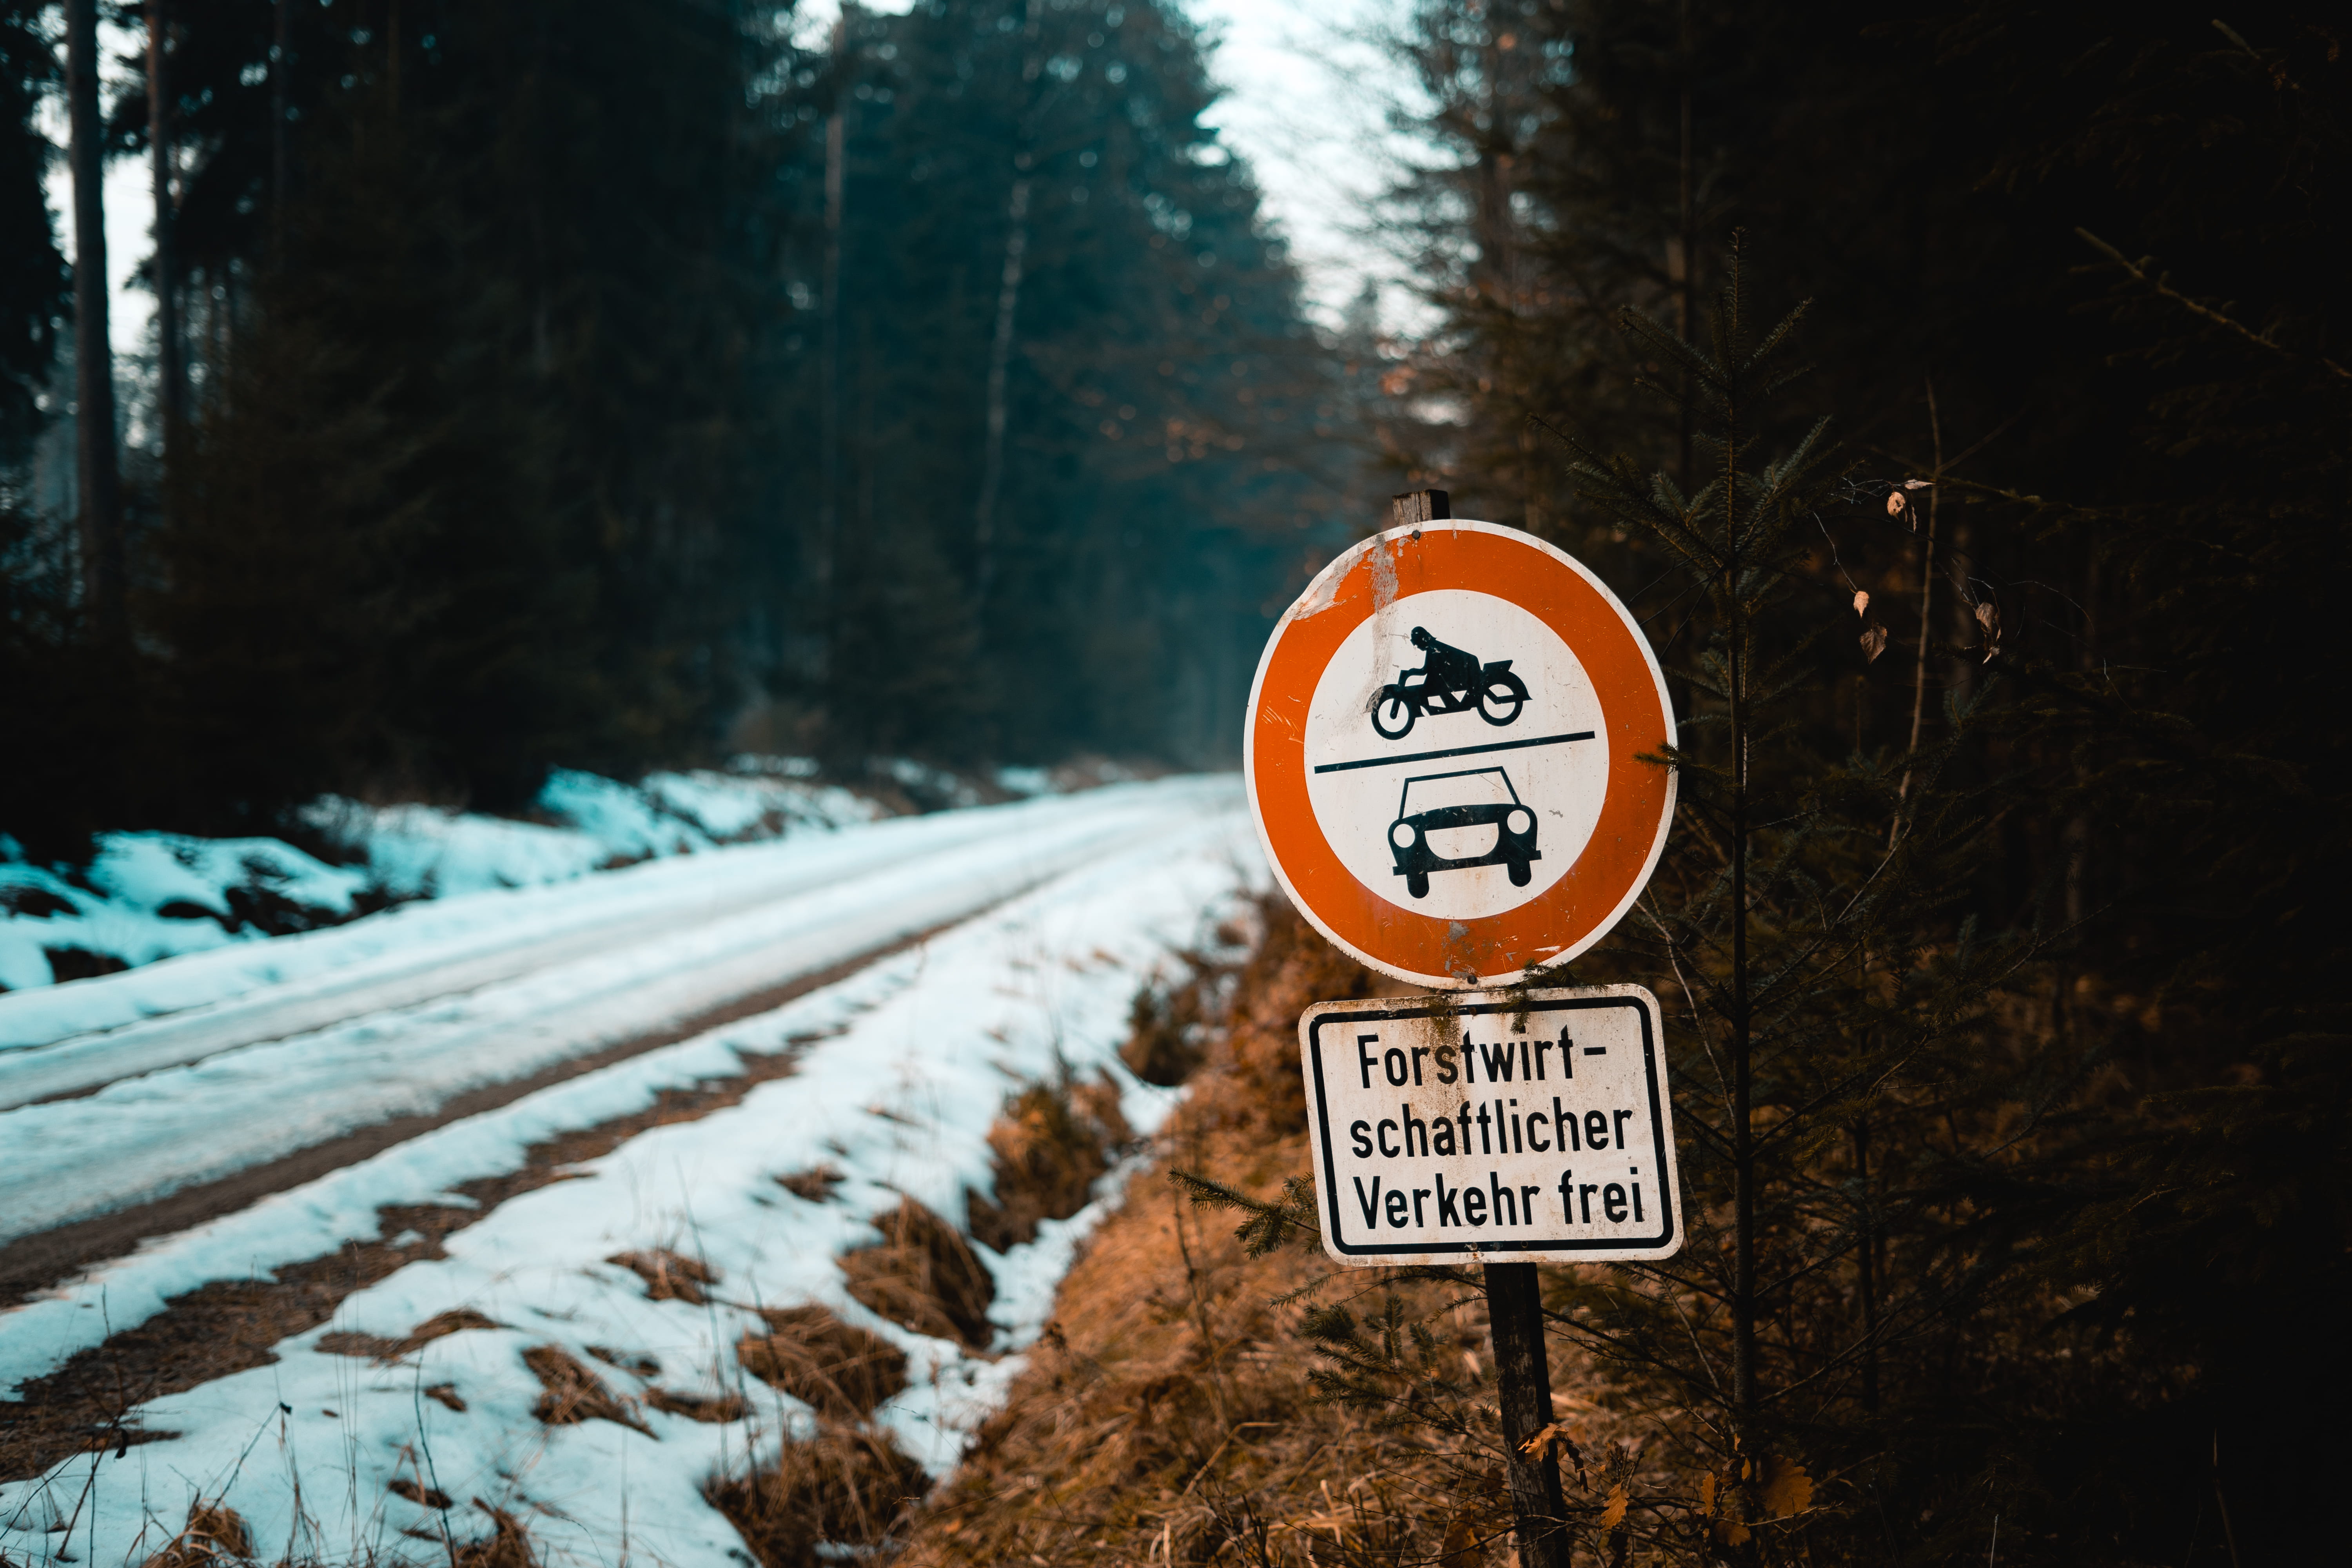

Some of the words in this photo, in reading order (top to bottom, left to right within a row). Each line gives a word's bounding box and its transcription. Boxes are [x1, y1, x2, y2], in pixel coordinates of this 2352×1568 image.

[1357, 1024, 1607, 1089] Forstwirt-
[1350, 1096, 1633, 1159] schaftlicher
[1352, 1171, 1541, 1230] Verkehr
[1557, 1166, 1645, 1225] frei
